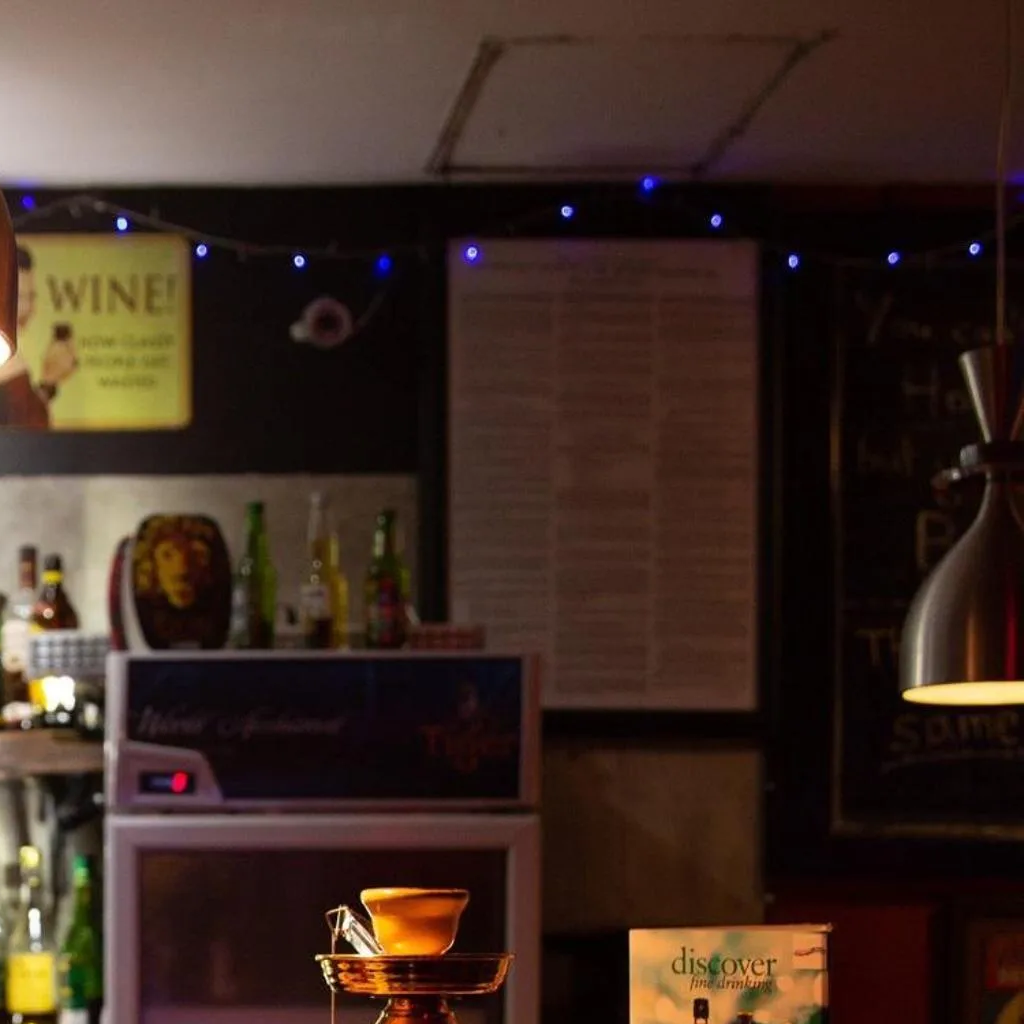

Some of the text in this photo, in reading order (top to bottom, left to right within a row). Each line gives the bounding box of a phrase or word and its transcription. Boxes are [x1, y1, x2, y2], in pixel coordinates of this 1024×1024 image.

[46, 272, 178, 315] WINE!
[672, 946, 777, 977] discover
[690, 976, 773, 993] fine drinking
